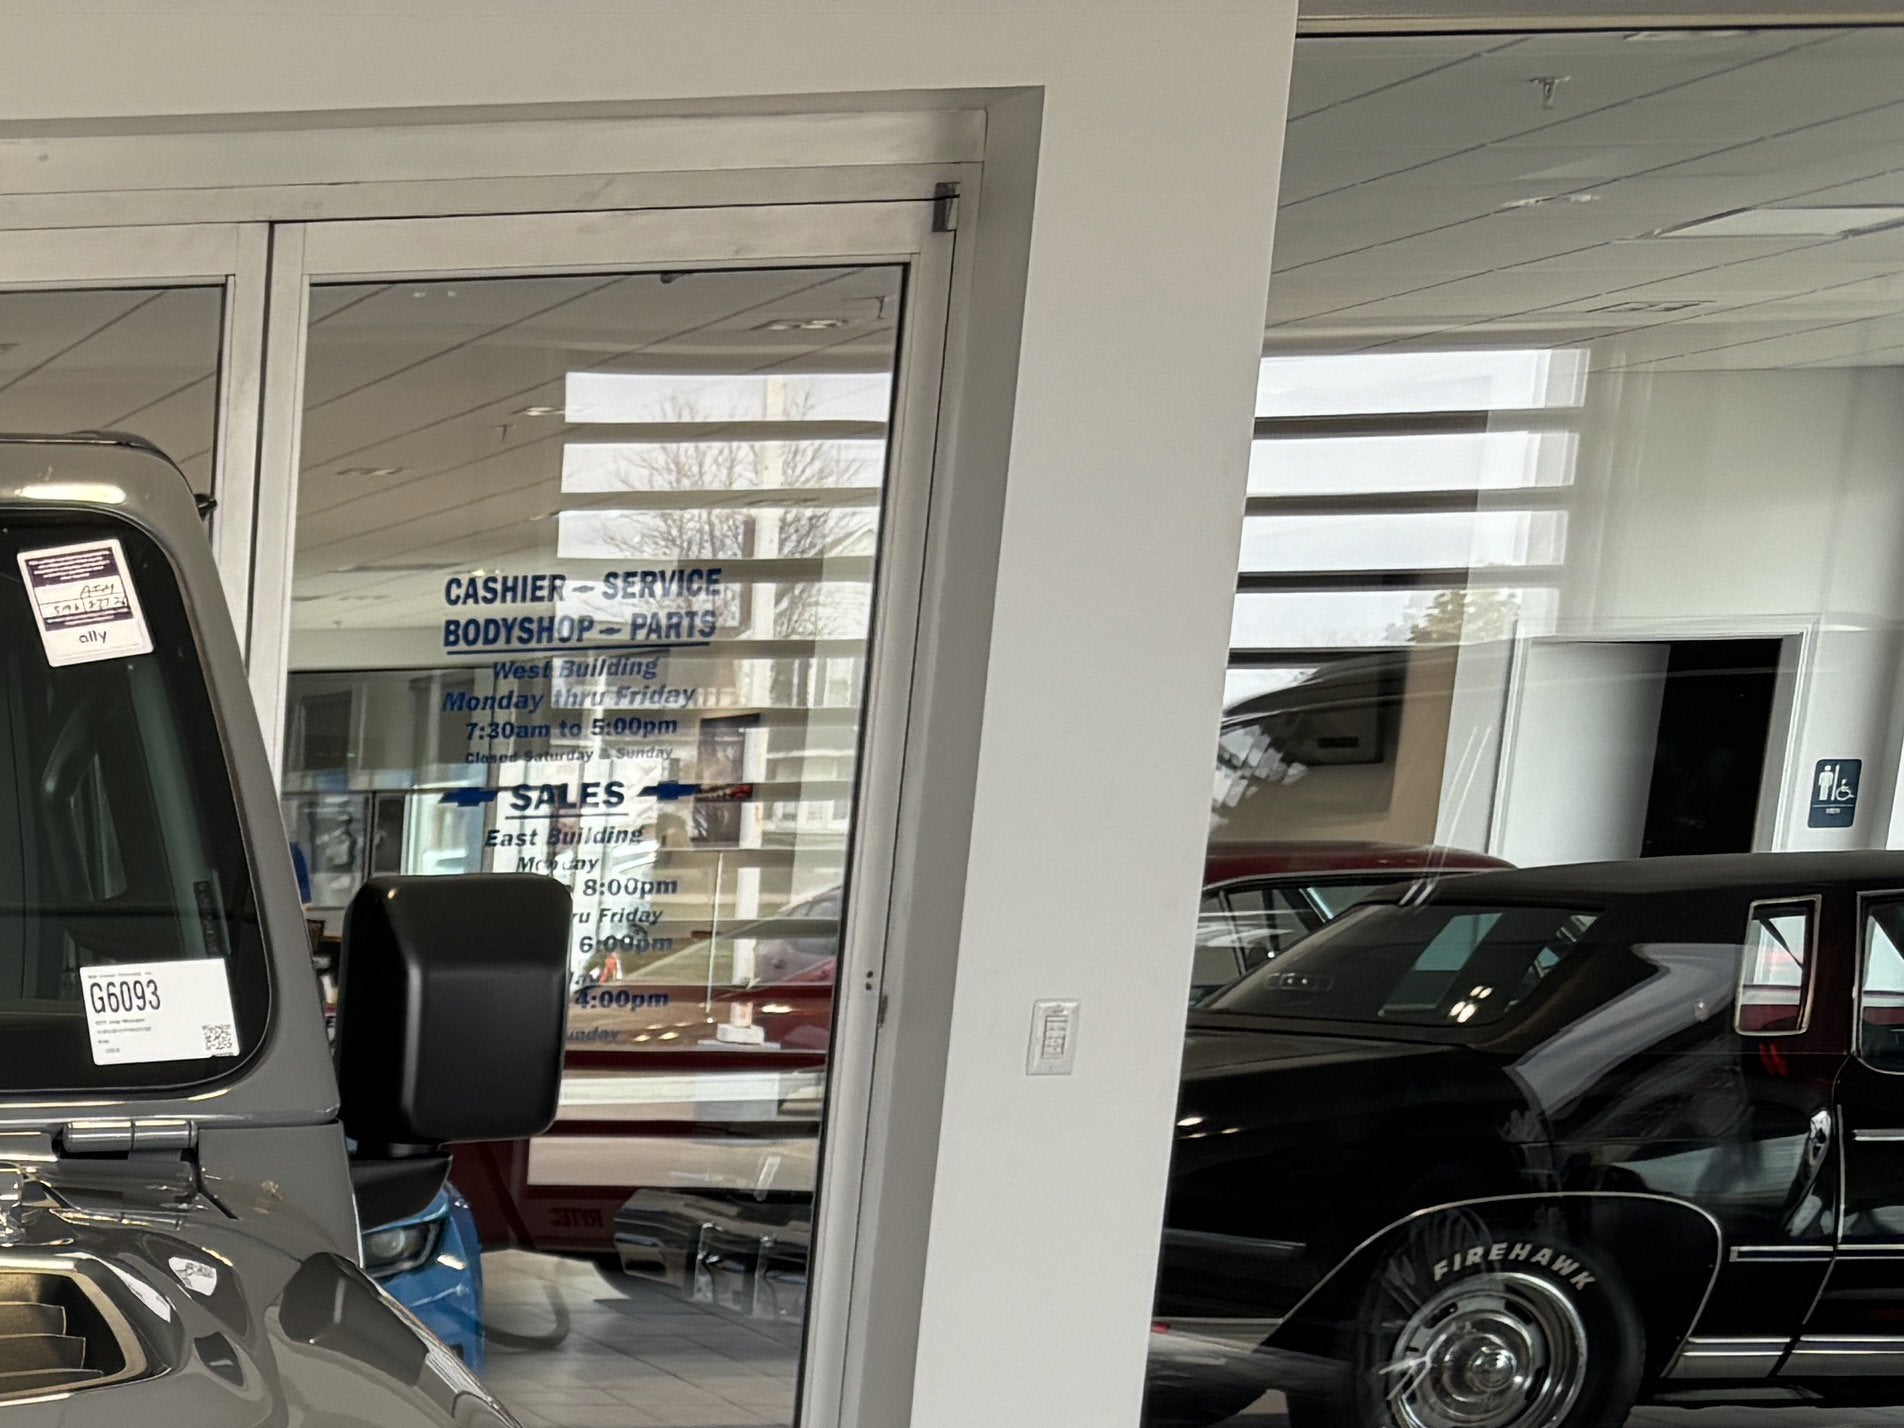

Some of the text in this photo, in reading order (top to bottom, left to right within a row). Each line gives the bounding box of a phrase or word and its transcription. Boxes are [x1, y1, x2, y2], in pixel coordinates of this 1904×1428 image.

[445, 568, 723, 606] CASHIER SERVICE
[78, 630, 108, 644] ally
[443, 609, 717, 647] BODYSHOP PARTS
[494, 656, 659, 680] West Building
[442, 685, 696, 712] Monday thru Friday
[465, 717, 678, 741] 7:30am to 5:00pm
[509, 781, 625, 812] SALES
[485, 825, 645, 847] East Building
[582, 877, 678, 899] 8:00pm
[598, 907, 664, 926] Friday
[579, 935, 674, 954] 6:00pm
[90, 979, 161, 1014] G6093
[574, 989, 669, 1012] 4:00pm
[568, 1026, 621, 1044] unday
[1433, 1242, 1597, 1291] FIREHAWK
